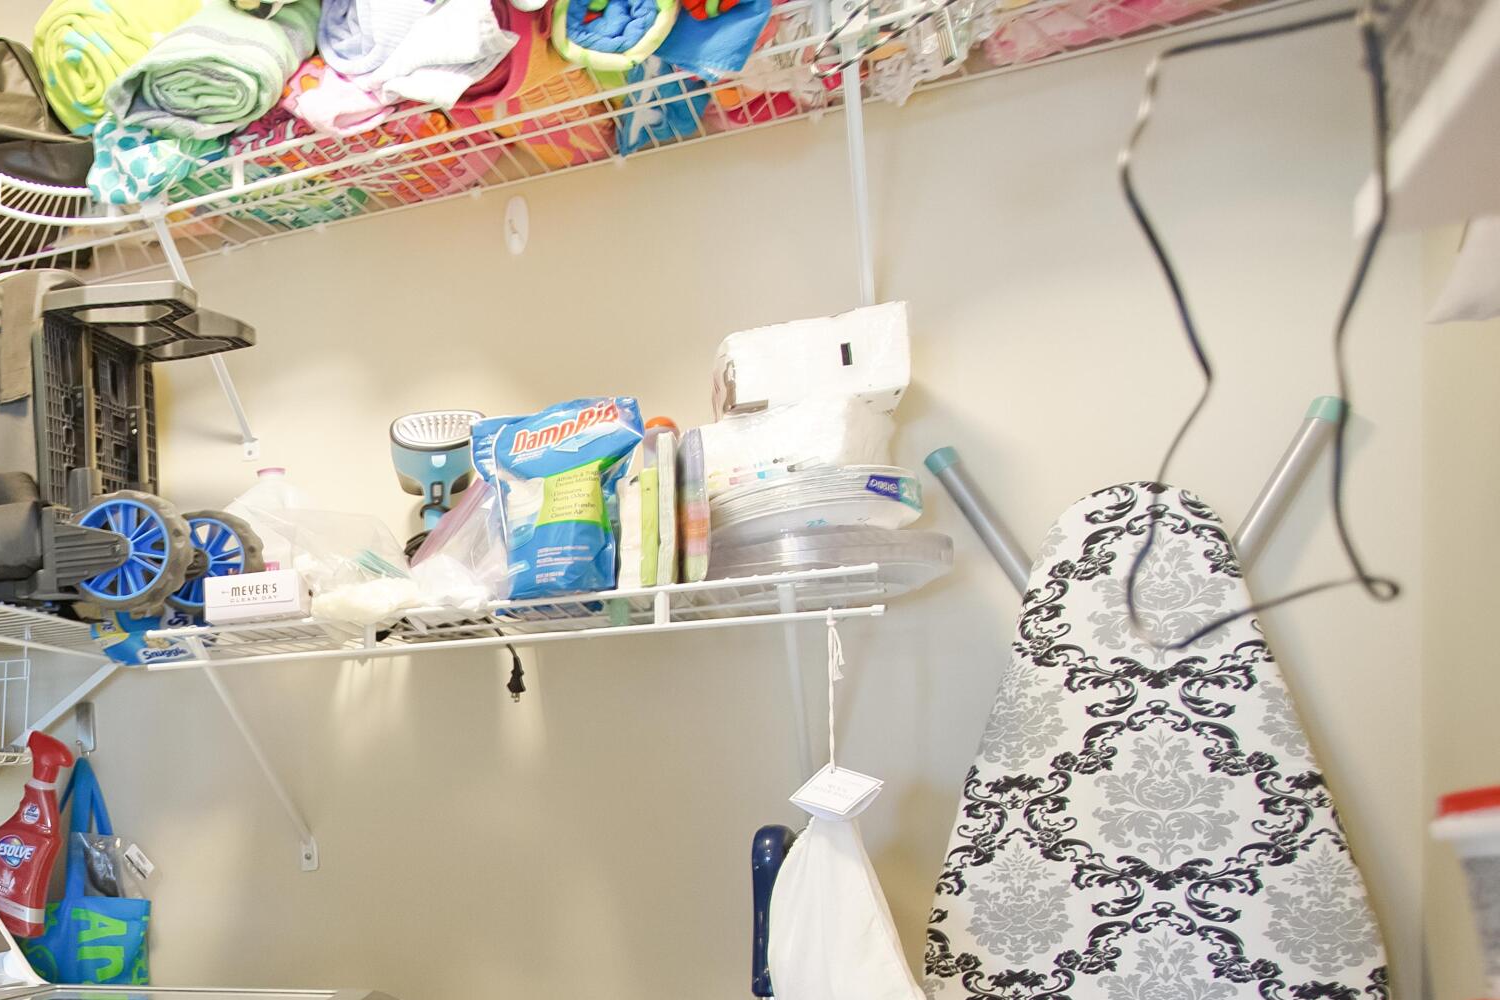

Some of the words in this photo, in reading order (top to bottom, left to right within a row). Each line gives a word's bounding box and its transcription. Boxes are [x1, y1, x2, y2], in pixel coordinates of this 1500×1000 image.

[511, 401, 620, 453] DampRid
[231, 583, 278, 597] MEYER'S
[143, 646, 188, 660] Snuggle
[71, 907, 128, 982] Ar
